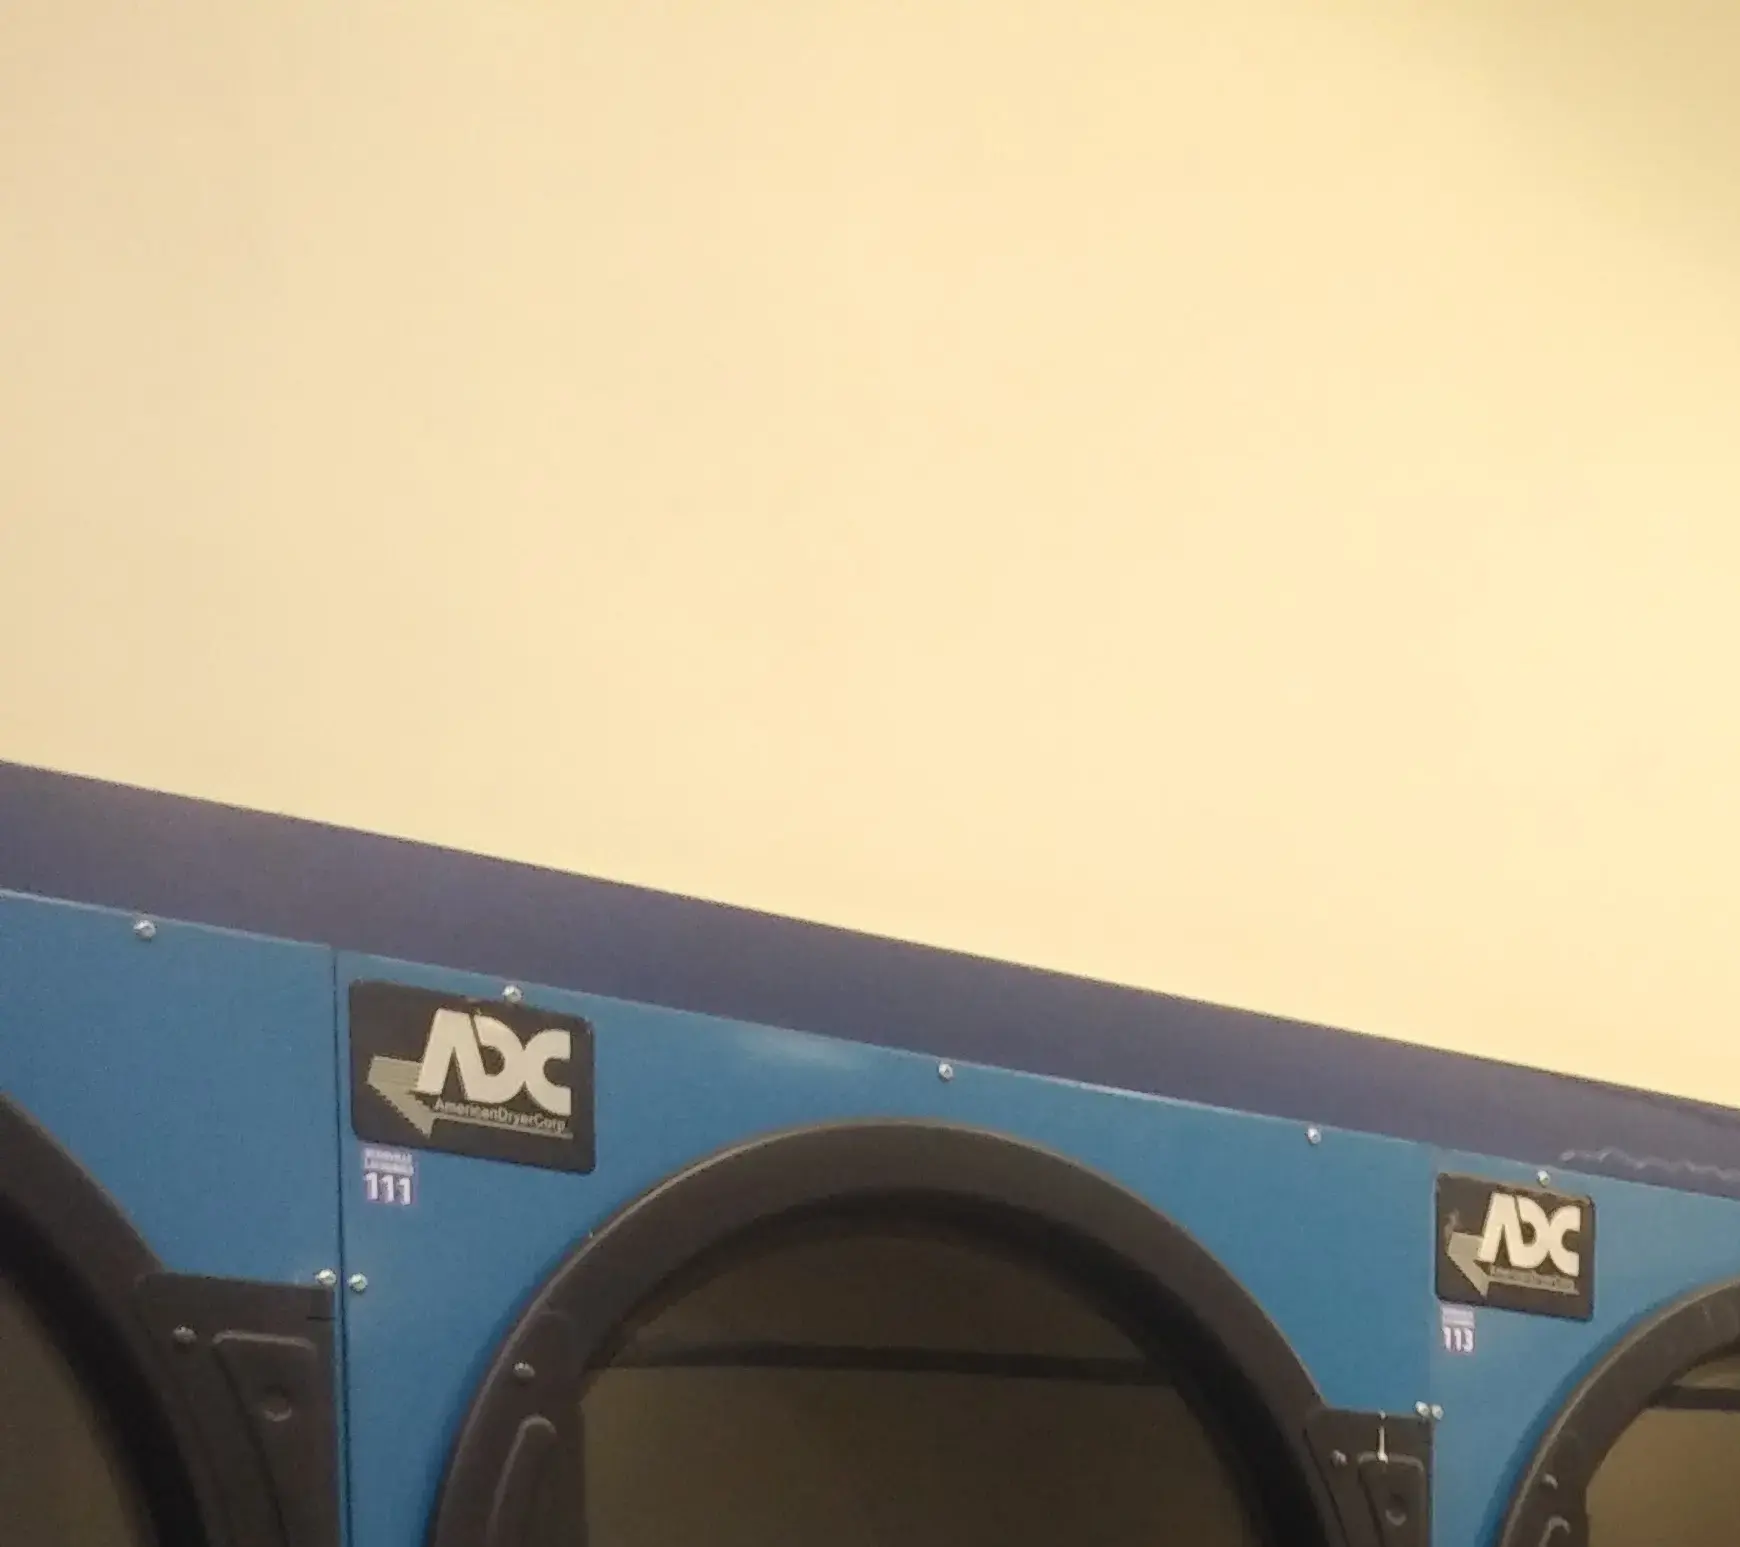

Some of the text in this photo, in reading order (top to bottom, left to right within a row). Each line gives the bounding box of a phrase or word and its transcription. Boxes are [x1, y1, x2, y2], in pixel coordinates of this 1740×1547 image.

[417, 1007, 572, 1116] ADC
[364, 1172, 412, 1206] 111
[1477, 1192, 1581, 1277] ADC
